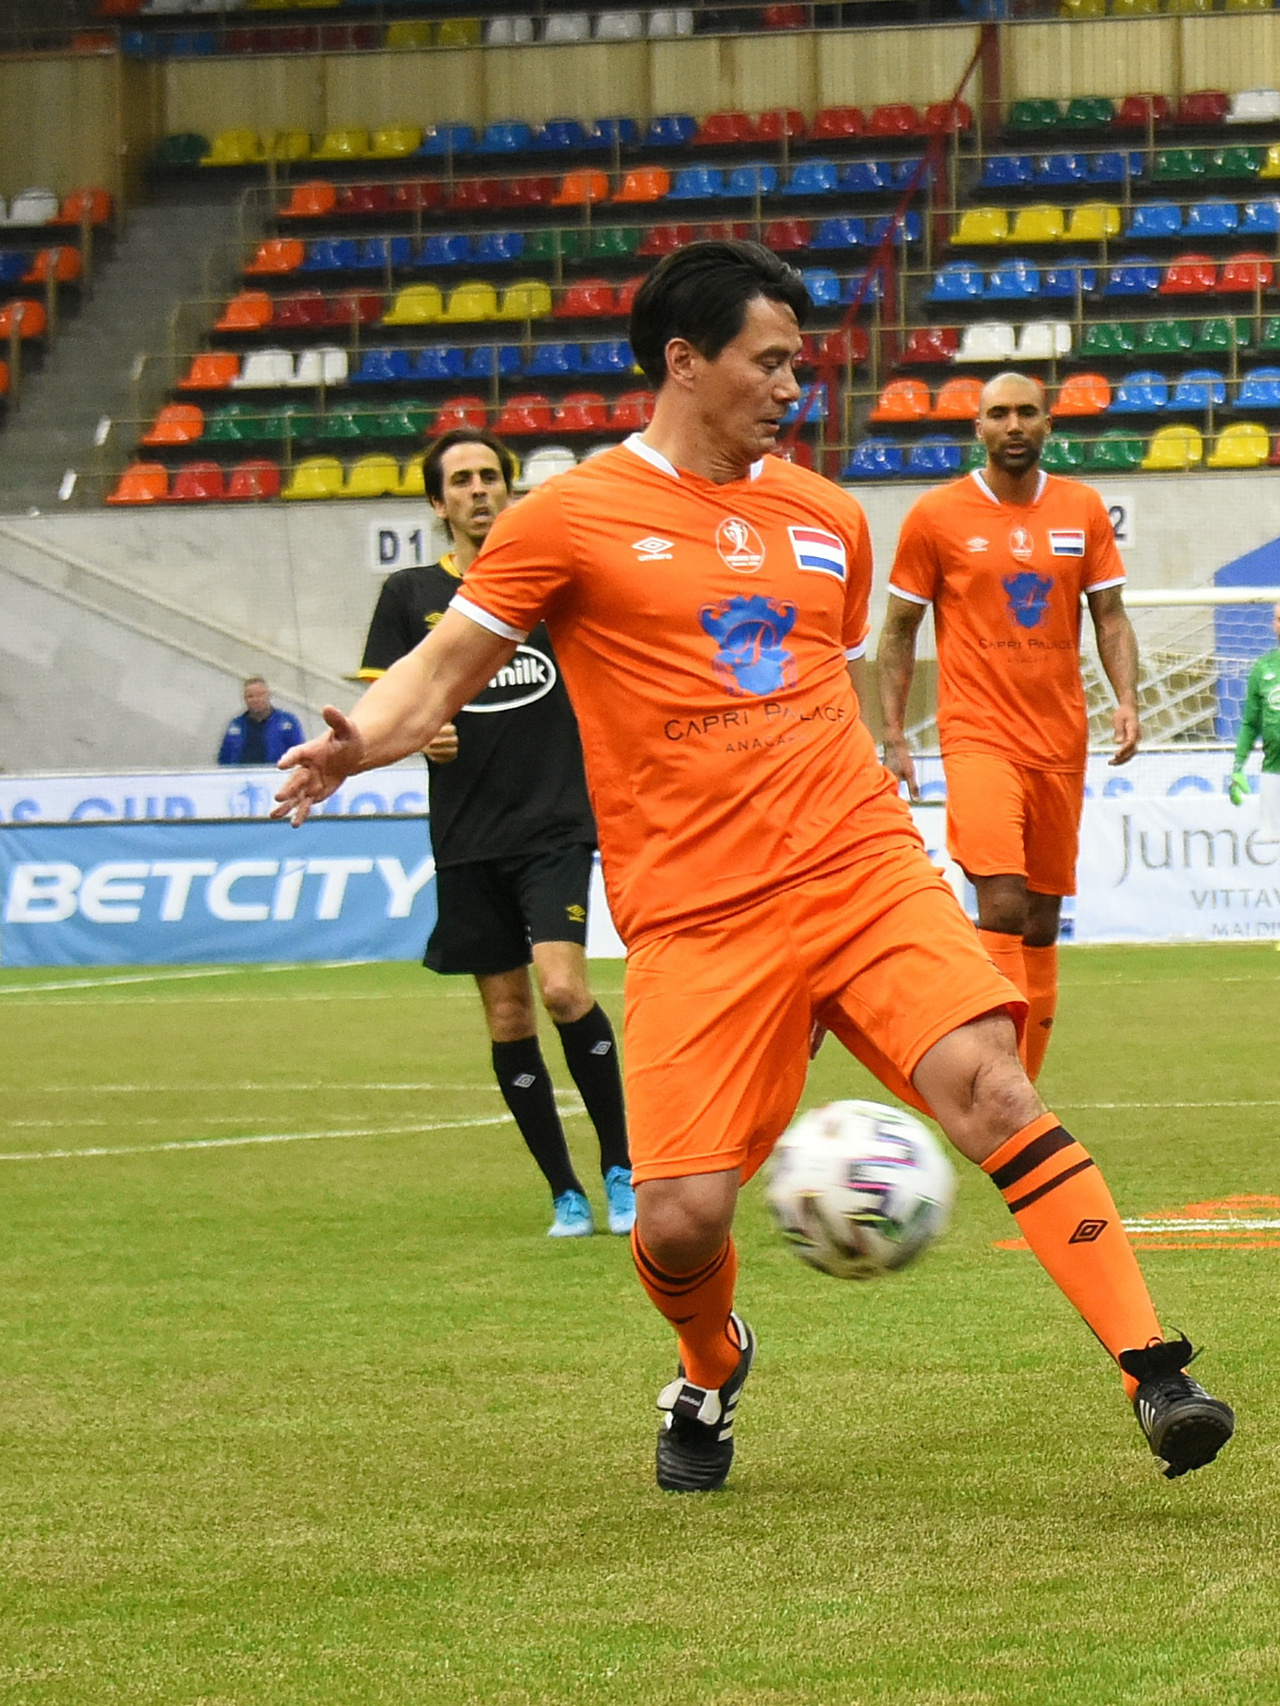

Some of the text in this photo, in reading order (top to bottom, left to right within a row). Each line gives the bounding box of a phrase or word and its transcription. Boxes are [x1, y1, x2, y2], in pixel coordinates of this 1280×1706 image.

[488, 657, 547, 688] milk
[664, 702, 845, 741] CAPRI PALACE
[6, 857, 436, 923] BETCITY
